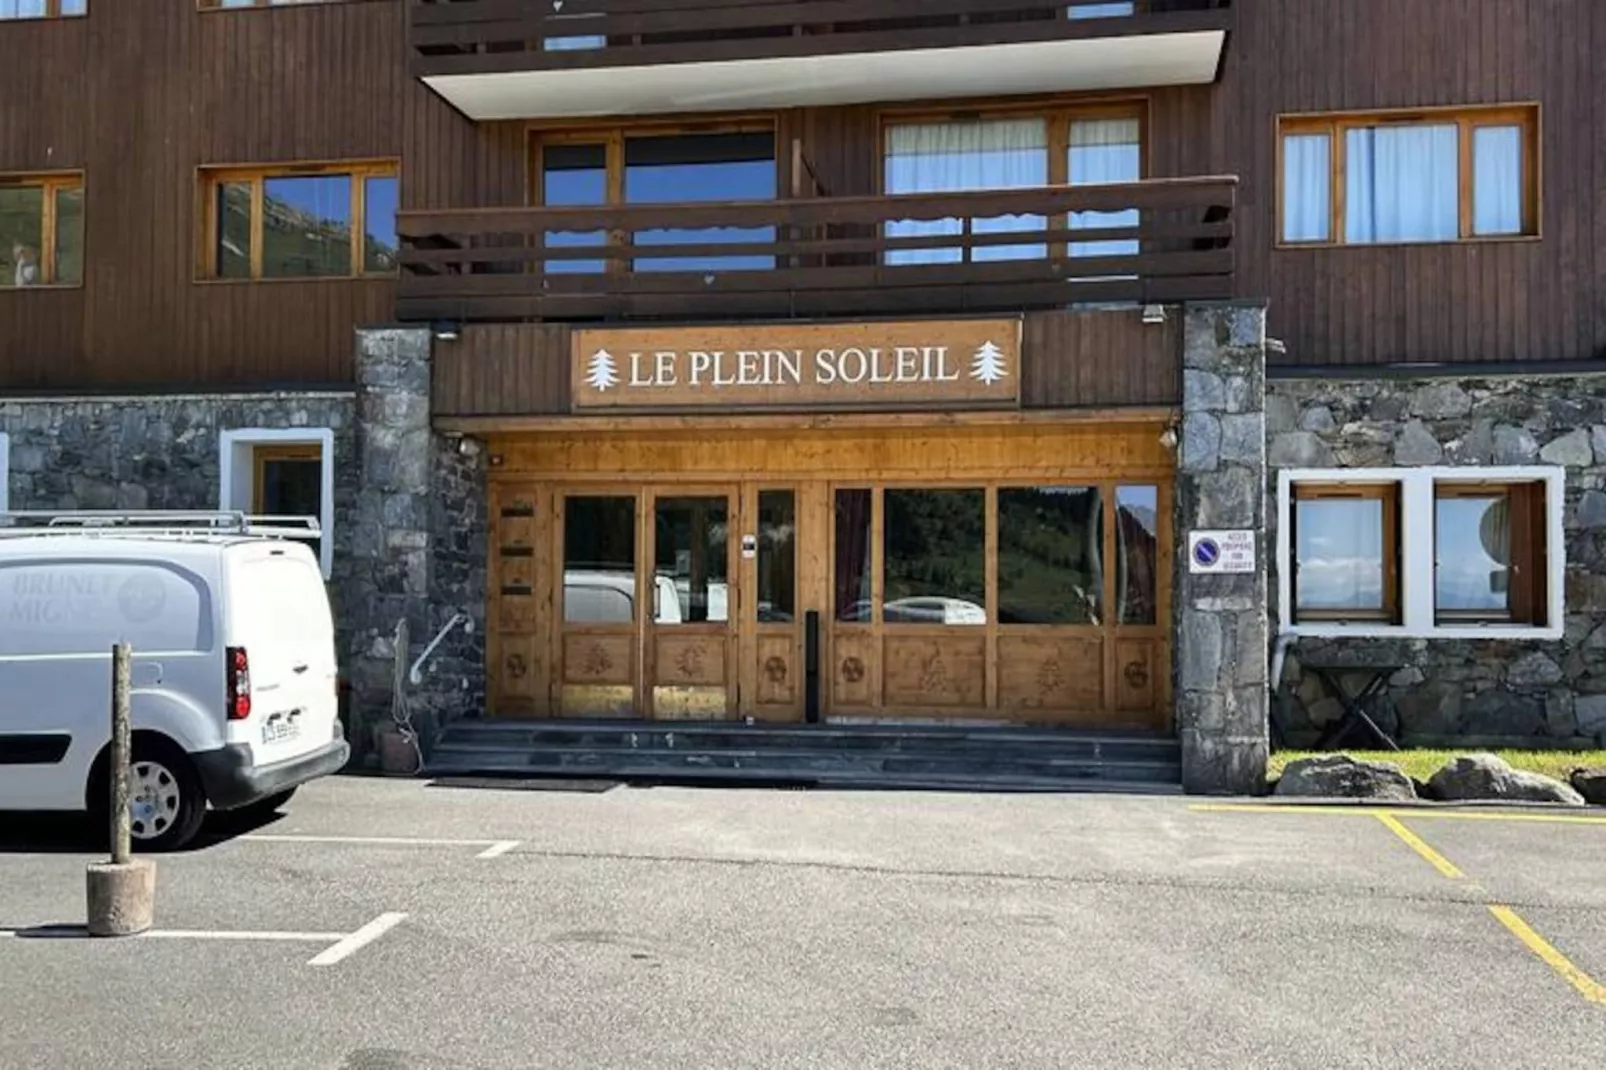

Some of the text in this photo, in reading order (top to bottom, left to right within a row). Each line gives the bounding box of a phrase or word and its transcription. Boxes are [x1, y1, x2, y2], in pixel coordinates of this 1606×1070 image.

[628, 346, 961, 386] LE PLEIN SOLEIL
